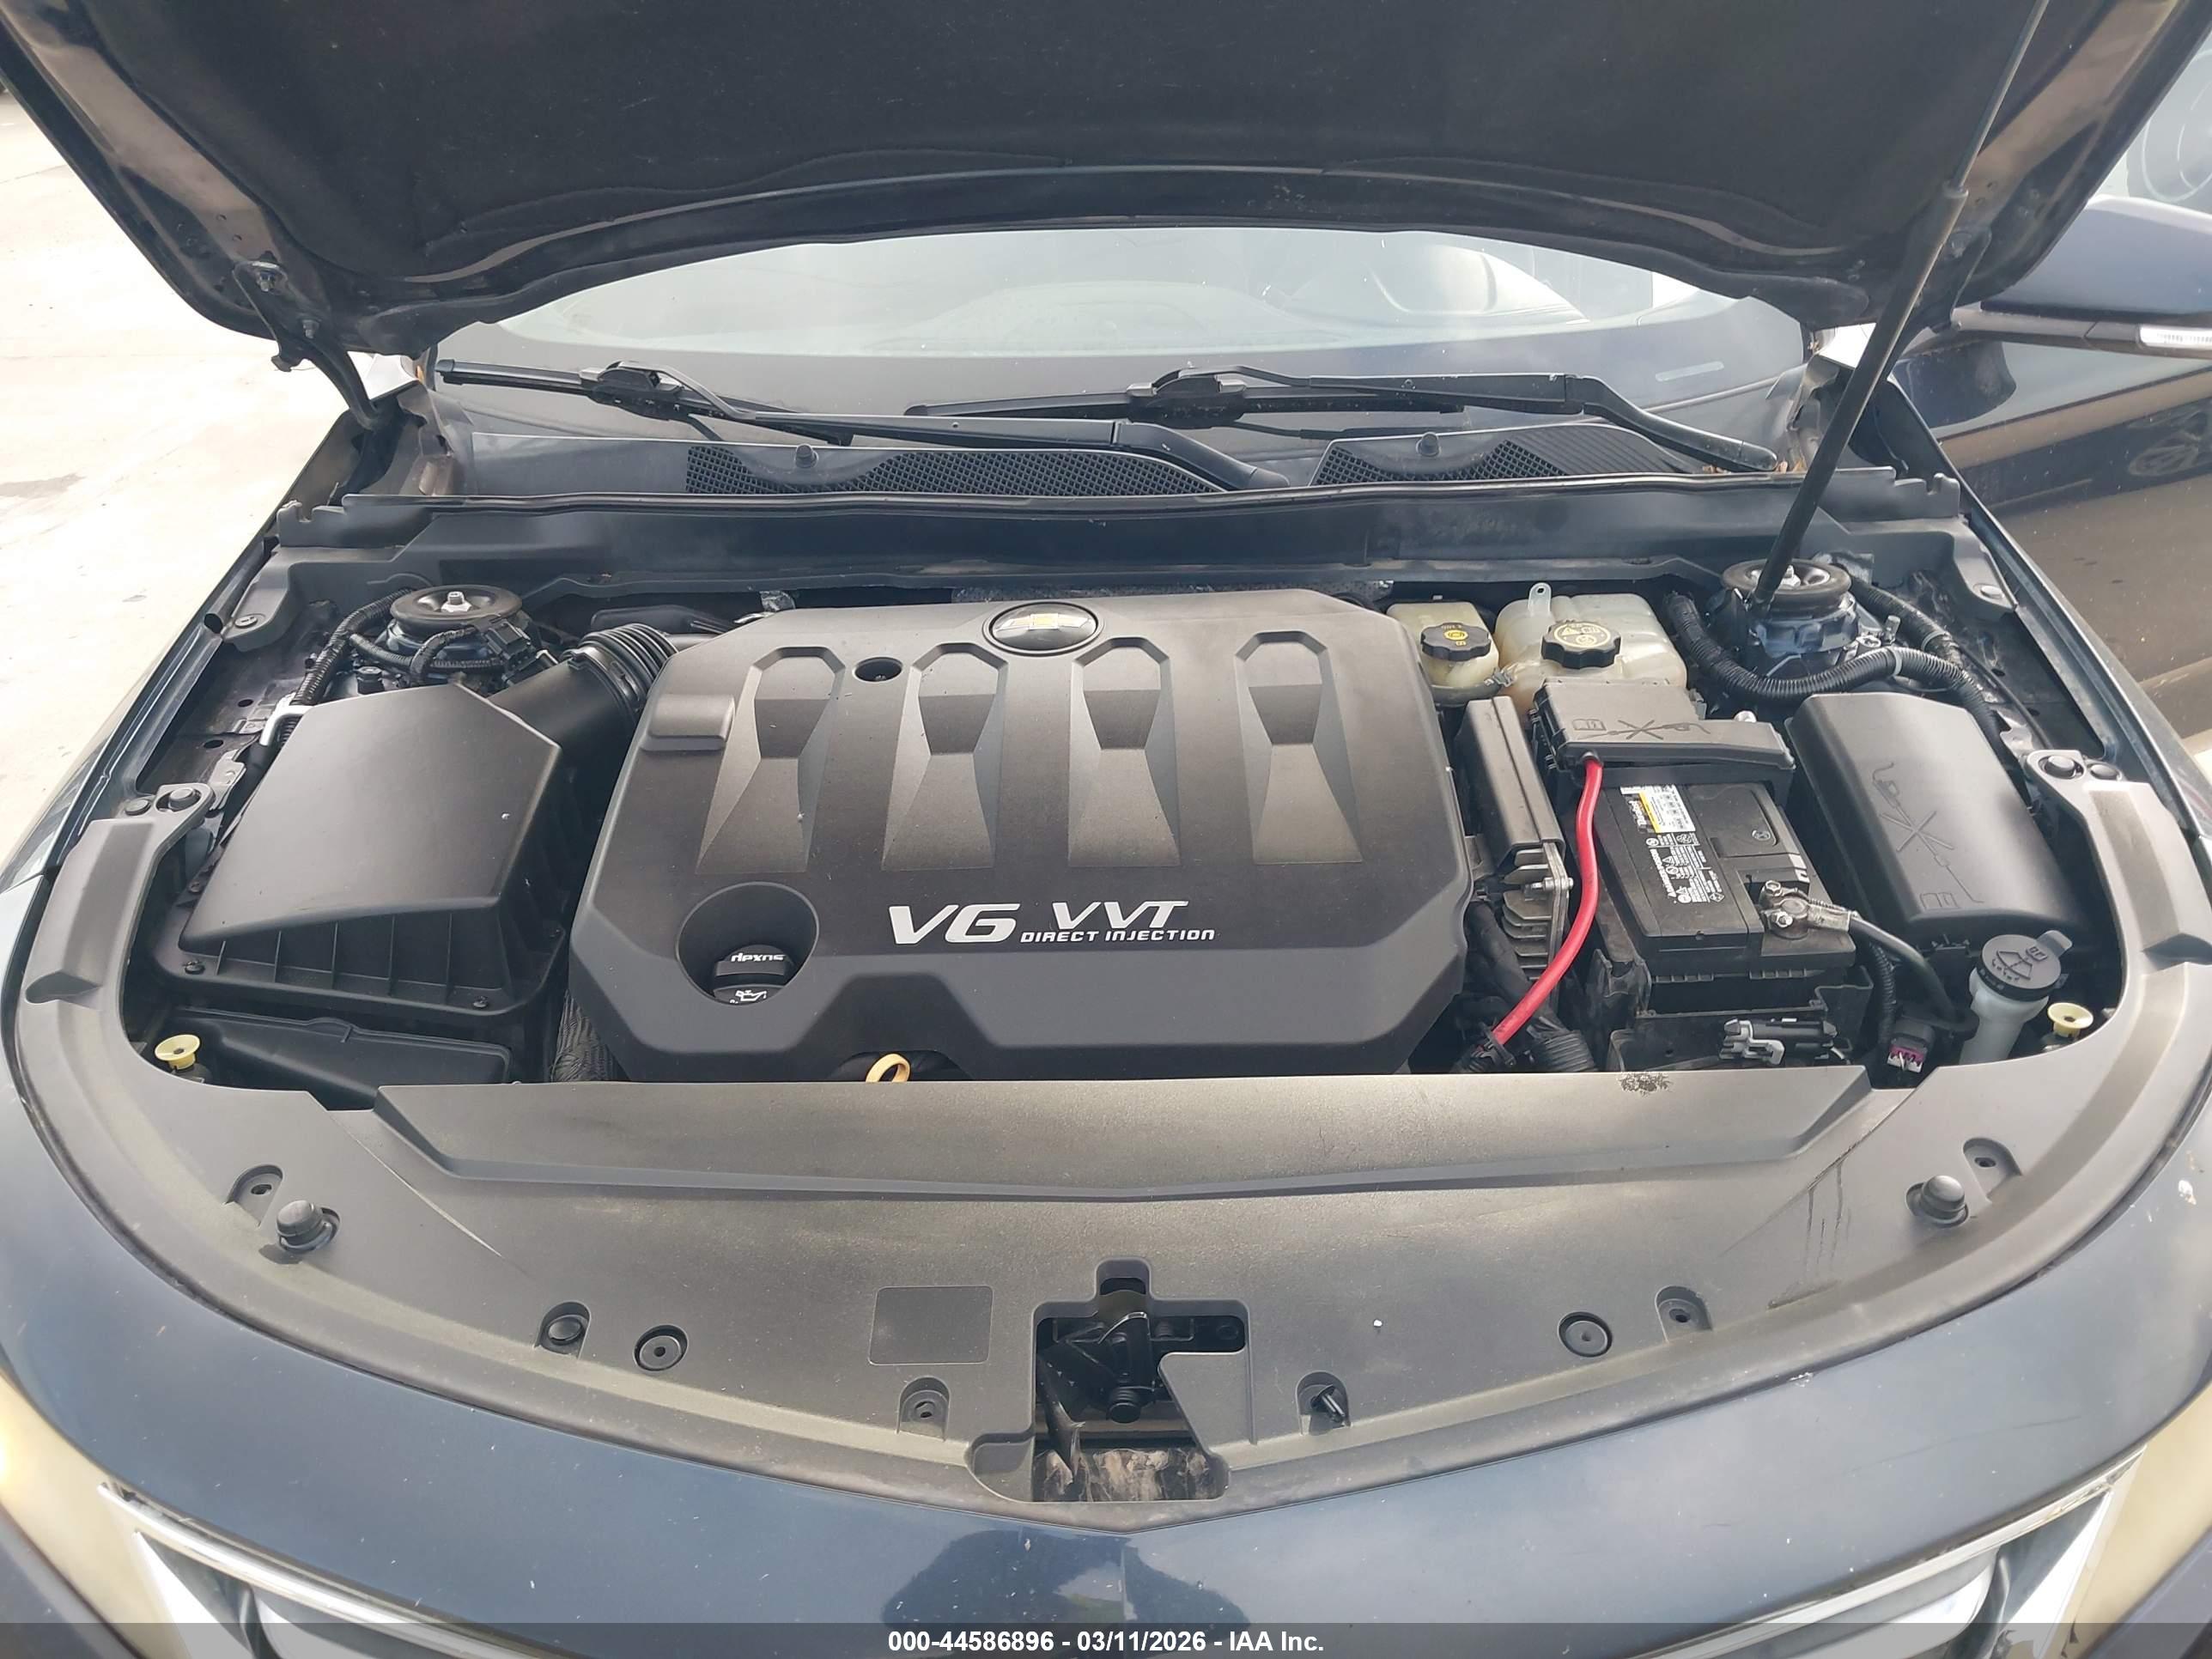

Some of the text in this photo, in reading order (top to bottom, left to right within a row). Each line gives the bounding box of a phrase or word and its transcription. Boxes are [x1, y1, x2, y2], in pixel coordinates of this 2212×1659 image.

[889, 903, 1022, 945] V6
[1052, 900, 1189, 930] VVT
[1020, 929, 1215, 943] DIRECT INJECTION
